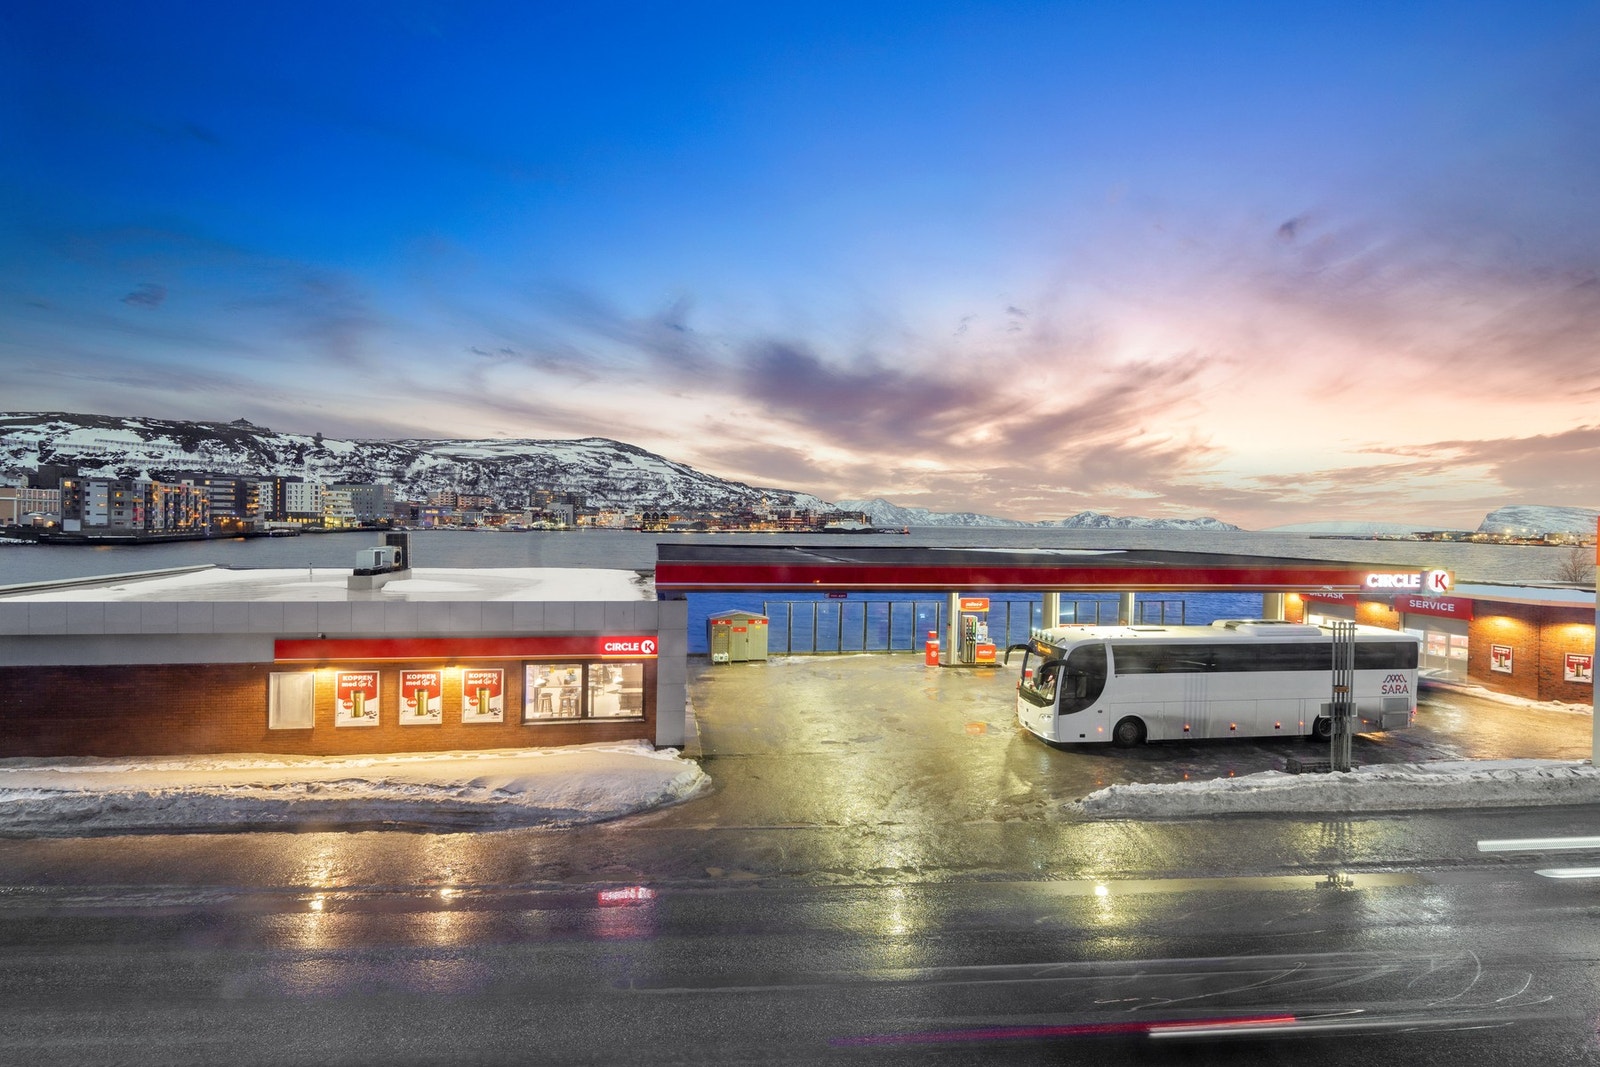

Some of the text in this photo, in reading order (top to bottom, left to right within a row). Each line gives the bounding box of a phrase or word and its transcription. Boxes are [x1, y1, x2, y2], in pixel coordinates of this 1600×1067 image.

[1366, 572, 1448, 591] CIRCLE K
[1409, 599, 1455, 612] SERVICE
[604, 641, 654, 653] CIRCLE K
[1381, 684, 1409, 695] SARA
